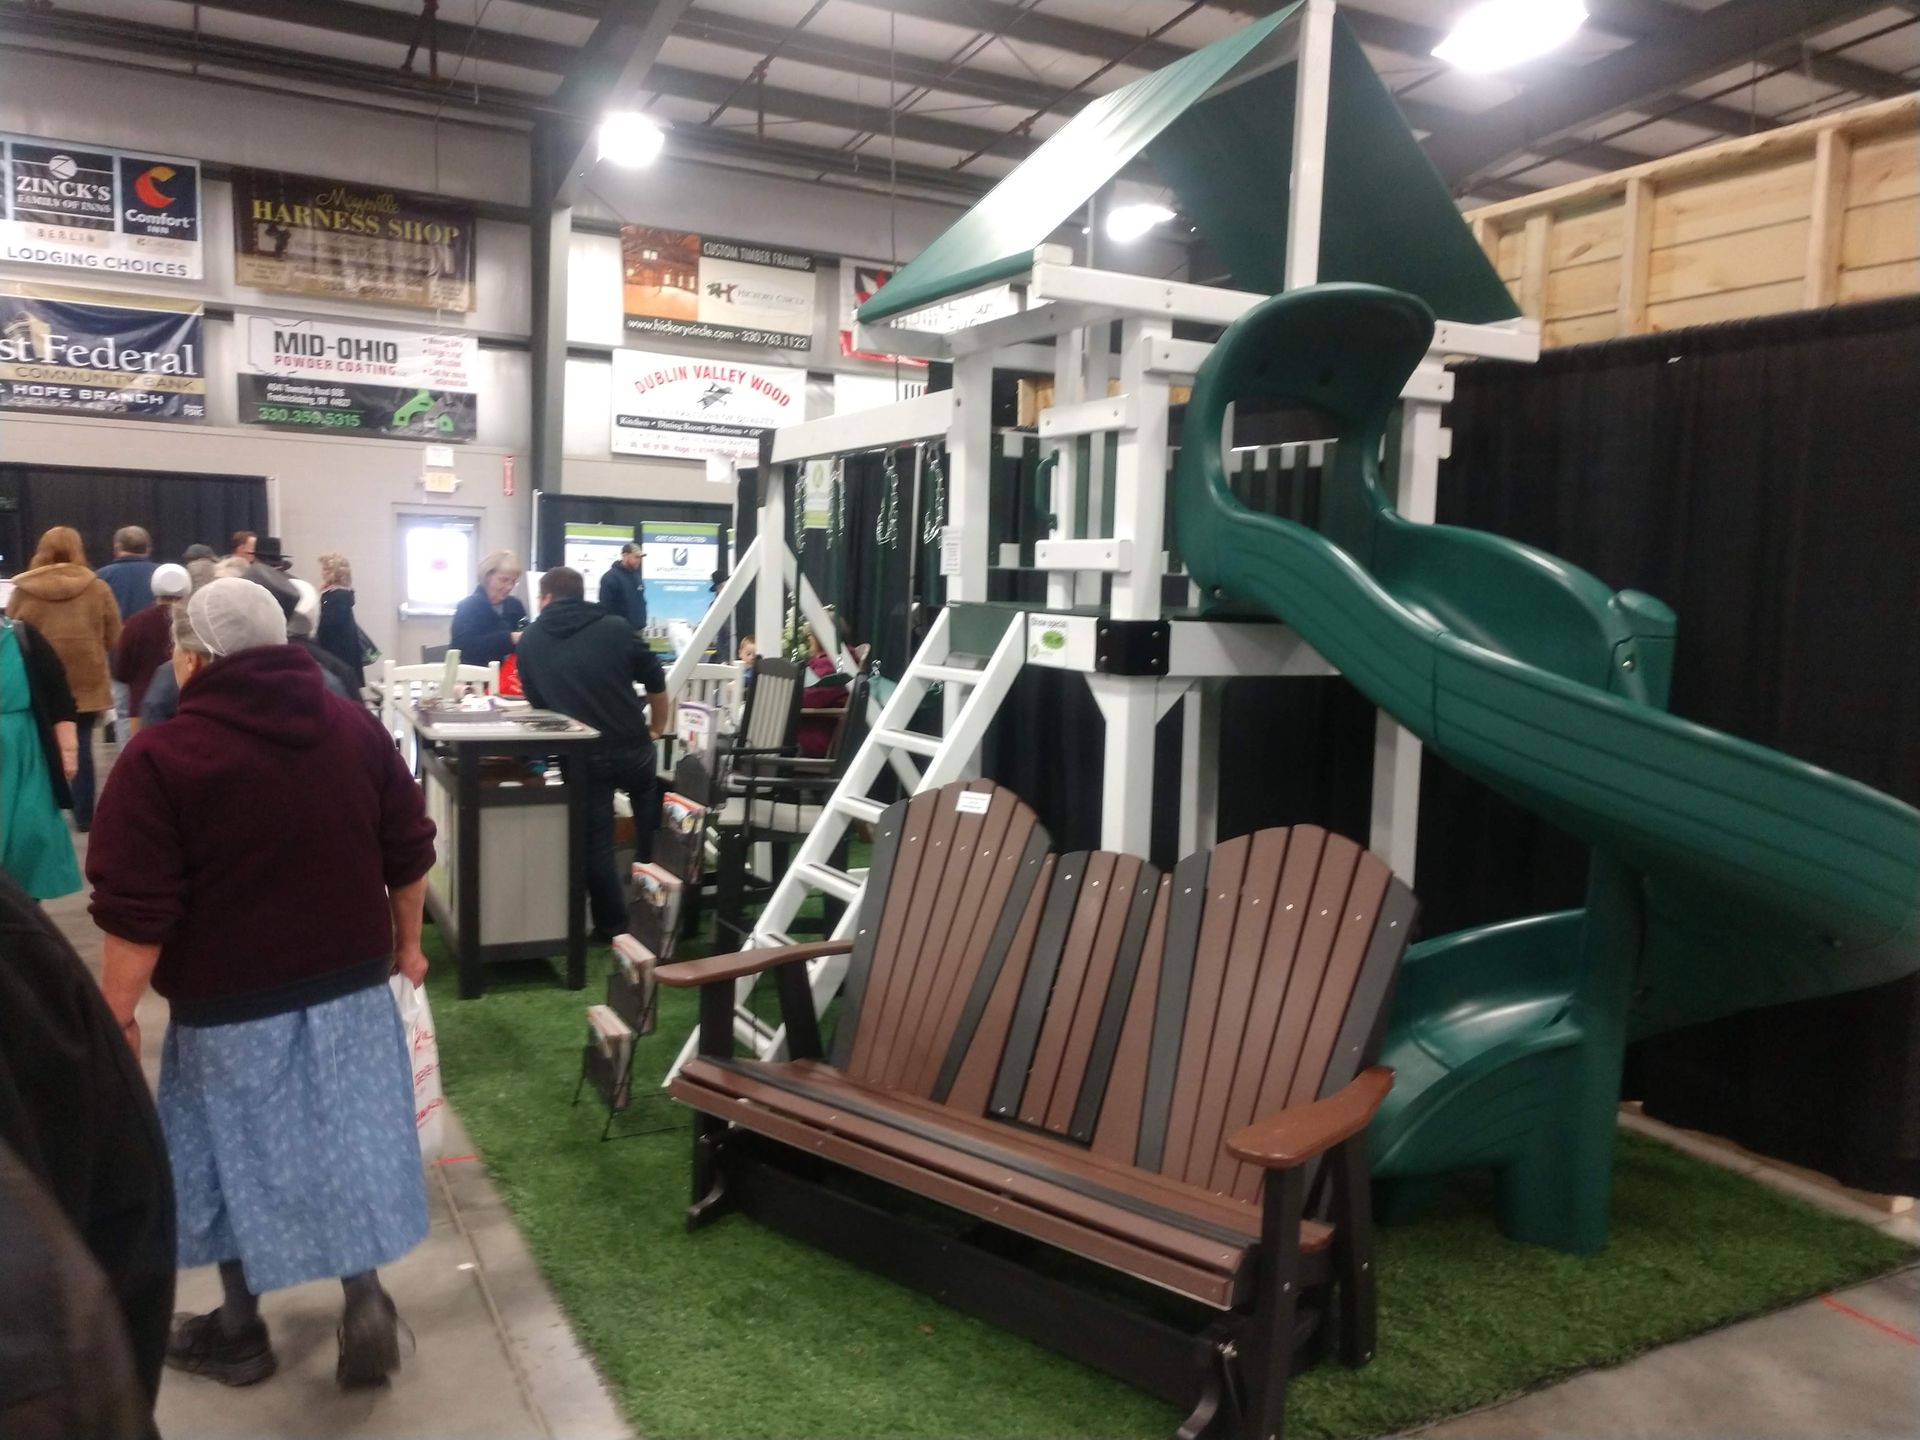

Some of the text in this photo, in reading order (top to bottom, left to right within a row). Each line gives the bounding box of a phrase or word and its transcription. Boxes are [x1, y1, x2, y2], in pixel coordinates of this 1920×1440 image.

[16, 175, 112, 202] ZINCK'S
[61, 198, 81, 211] OF
[125, 209, 191, 228] Comfort
[252, 199, 461, 244] HARNESS SHOP
[37, 228, 96, 243] BERLIN
[7, 246, 188, 277] LODGING CHOICES
[703, 241, 812, 270] CUSTOM TIMBER FRAMING
[40, 334, 198, 376] Federal
[273, 330, 399, 364] MID-OHIO
[273, 354, 397, 376] POWDER COATING
[15, 366, 193, 391] COMMUNITY BANK
[634, 365, 791, 407] DUBLIN VALLEY WOOD
[13, 384, 72, 399] HOPE
[79, 389, 165, 406] BRANCH
[258, 405, 361, 428] 330.359.5315
